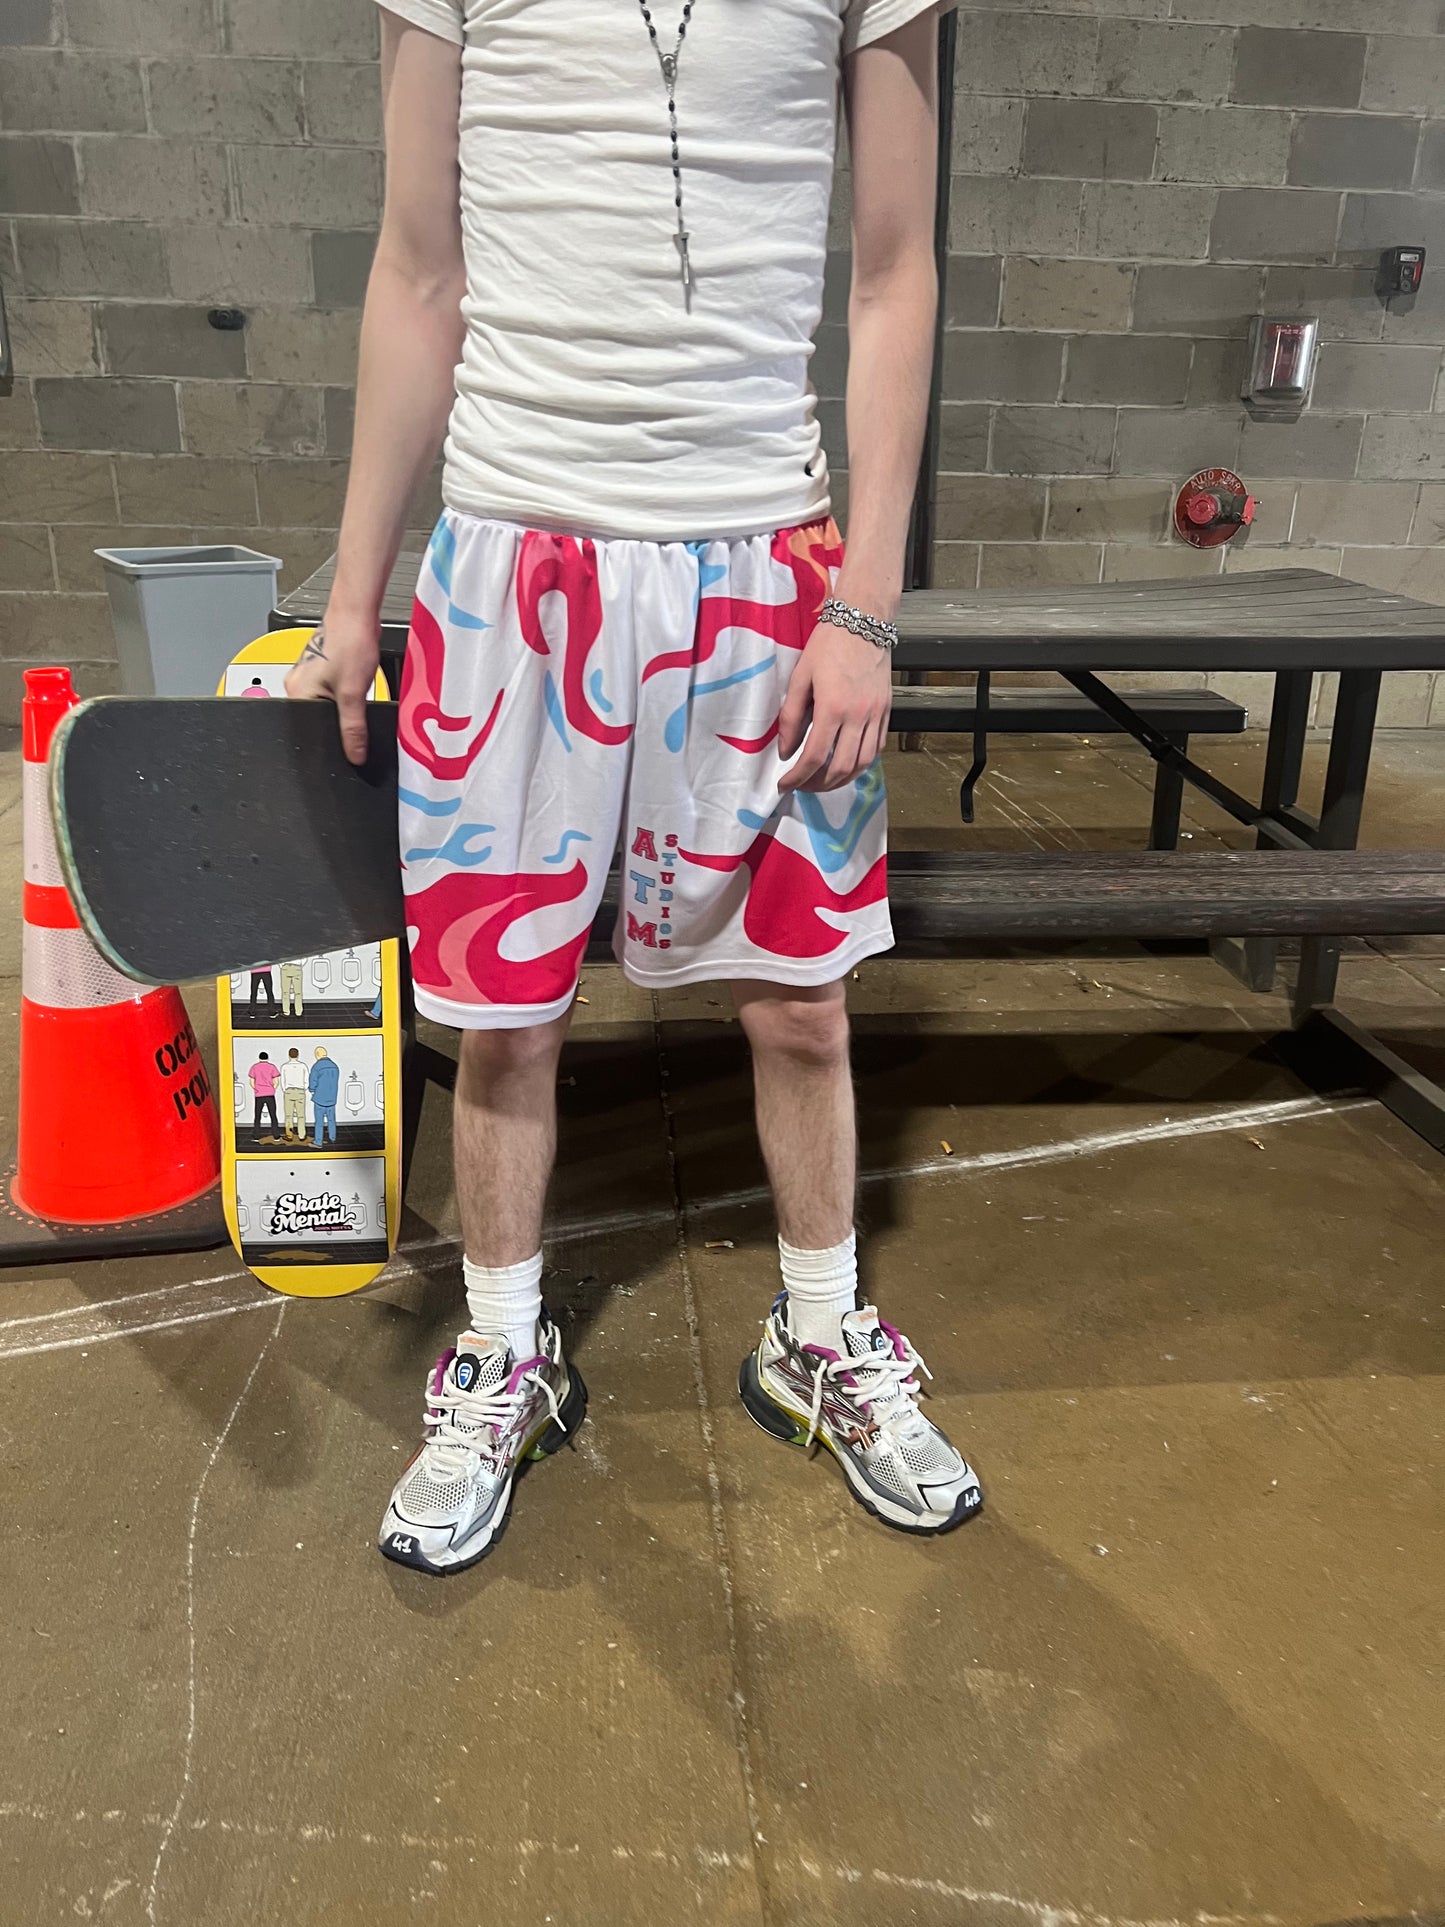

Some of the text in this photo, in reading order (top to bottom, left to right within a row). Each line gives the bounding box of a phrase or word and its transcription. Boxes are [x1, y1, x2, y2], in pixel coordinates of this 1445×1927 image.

[1190, 471, 1215, 489] AUTO
[626, 826, 659, 949] ATM
[659, 833, 679, 950] STUDIOS
[276, 1192, 341, 1214] Skate
[272, 1205, 356, 1233] Mental
[391, 1534, 412, 1554] 41
